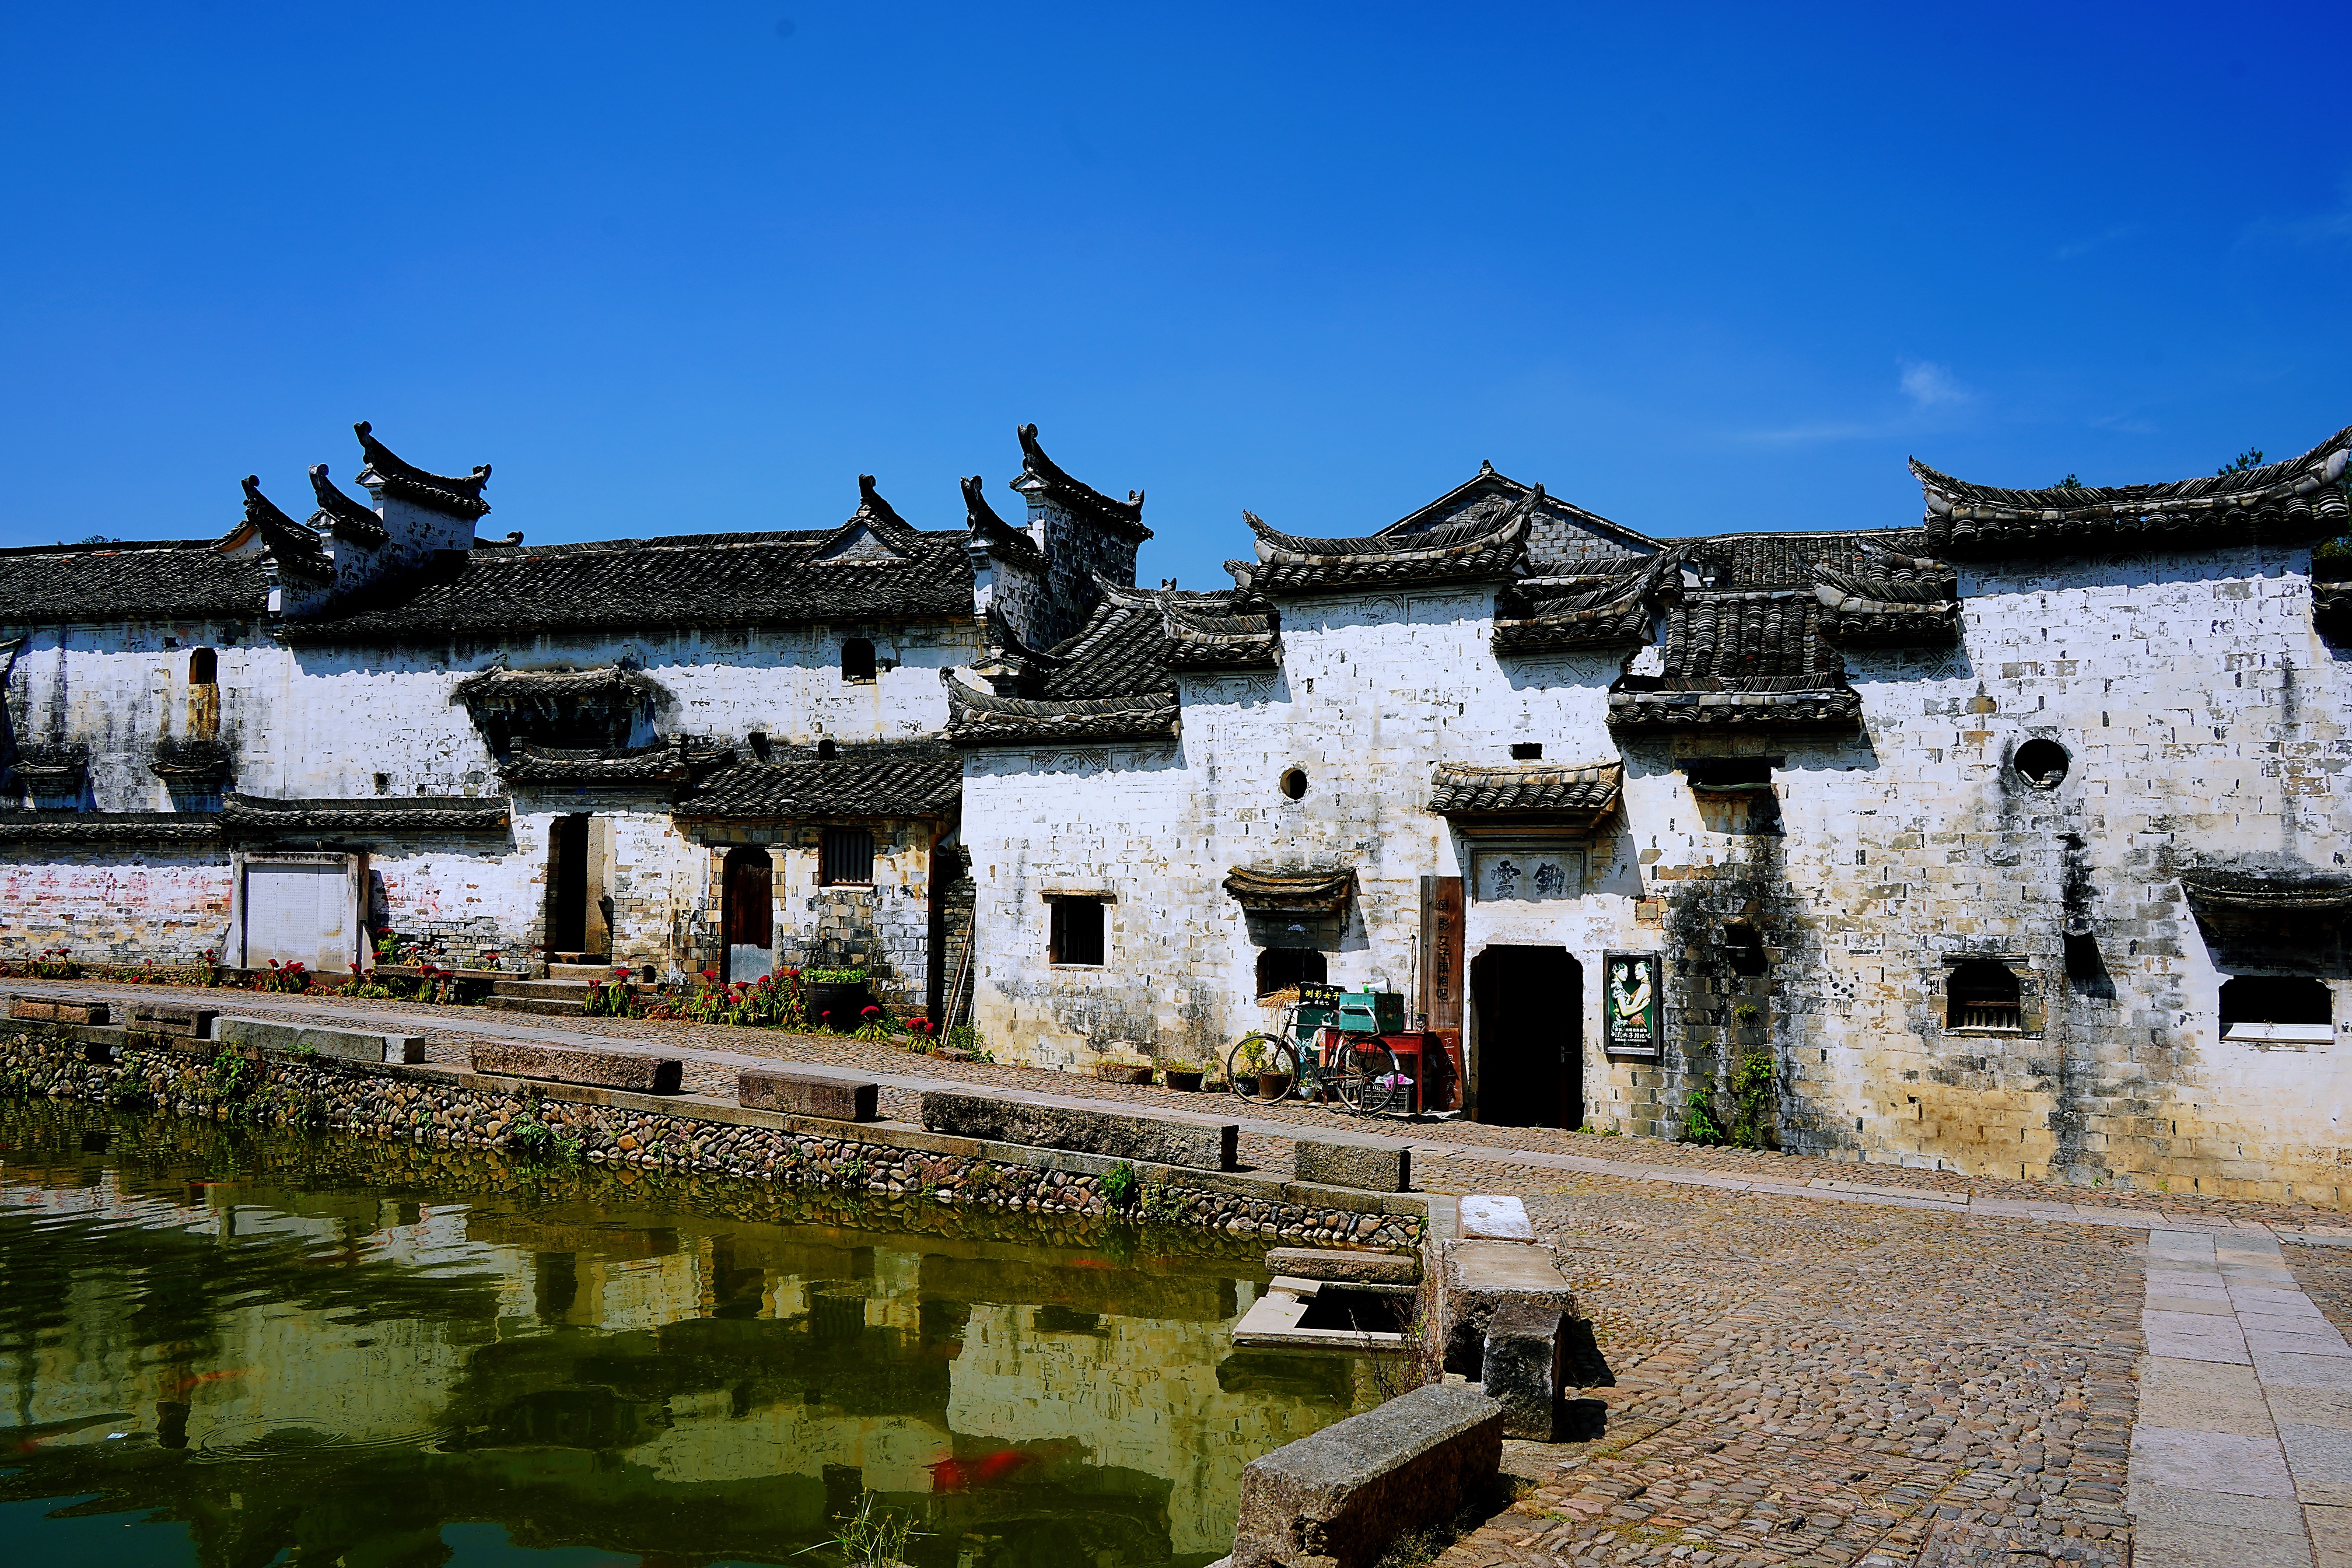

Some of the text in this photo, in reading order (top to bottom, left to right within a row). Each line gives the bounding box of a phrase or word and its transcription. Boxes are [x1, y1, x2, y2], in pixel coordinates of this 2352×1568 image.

[1437, 899, 1449, 1000] 倒影女子旗袍吧
[1305, 989, 1340, 1001] 倒影女子
